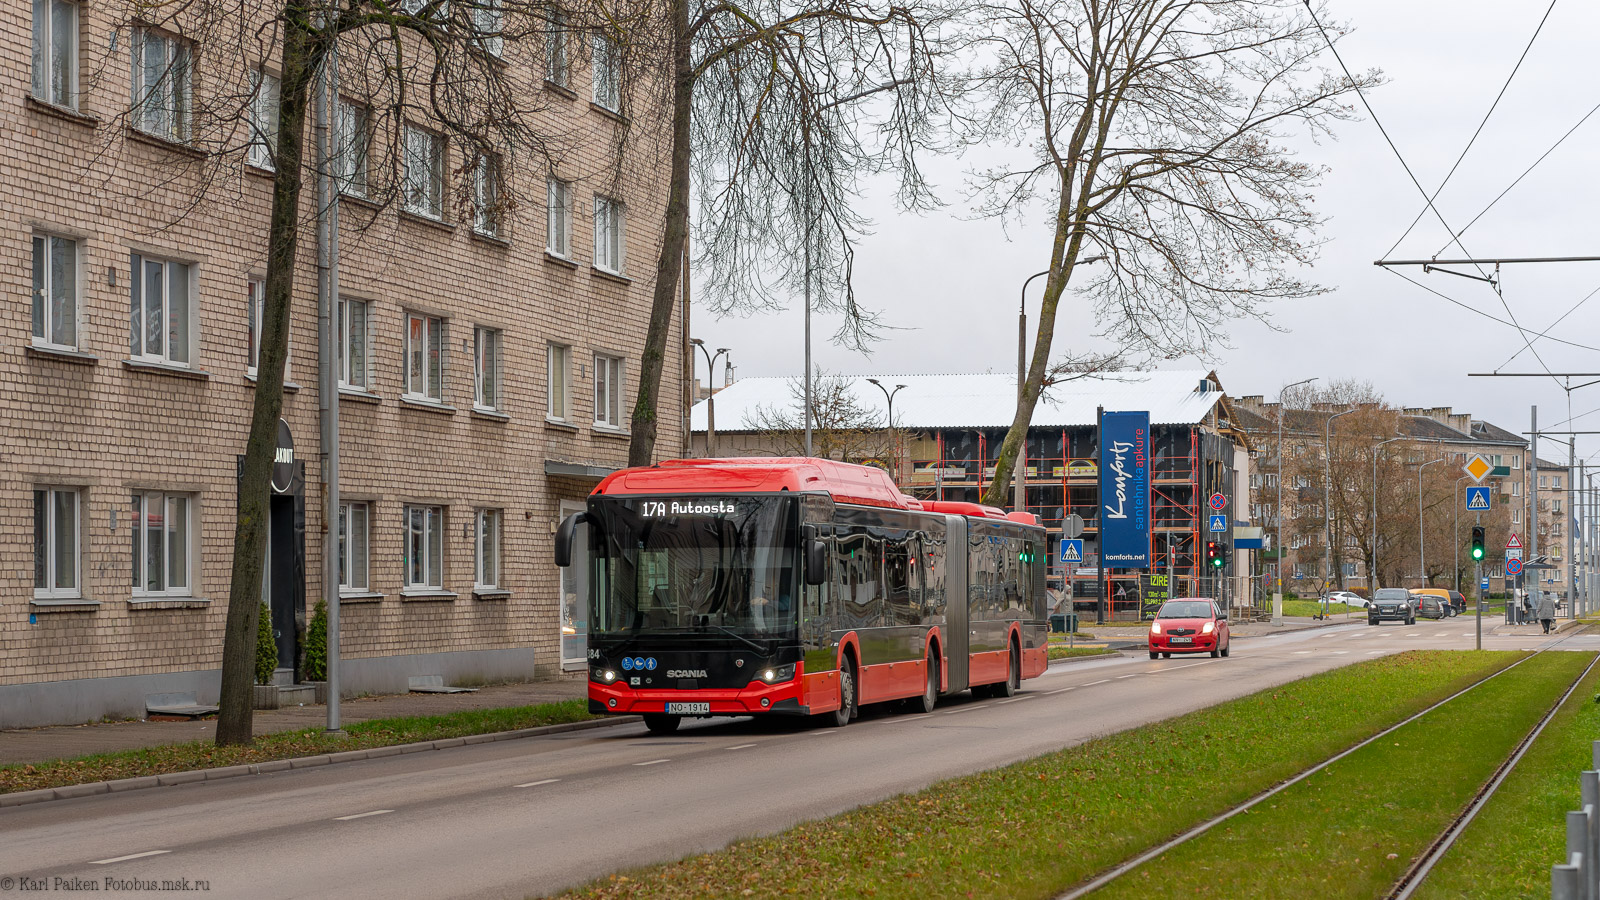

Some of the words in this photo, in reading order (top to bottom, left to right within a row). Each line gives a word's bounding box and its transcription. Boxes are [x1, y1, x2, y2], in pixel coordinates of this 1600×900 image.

[274, 447, 293, 464] AKOUT
[642, 501, 666, 517] 17A
[671, 500, 735, 514] Autoosta
[1105, 553, 1145, 561] komforts.net
[666, 669, 708, 678] SCANIA
[670, 703, 709, 712] NO-1914
